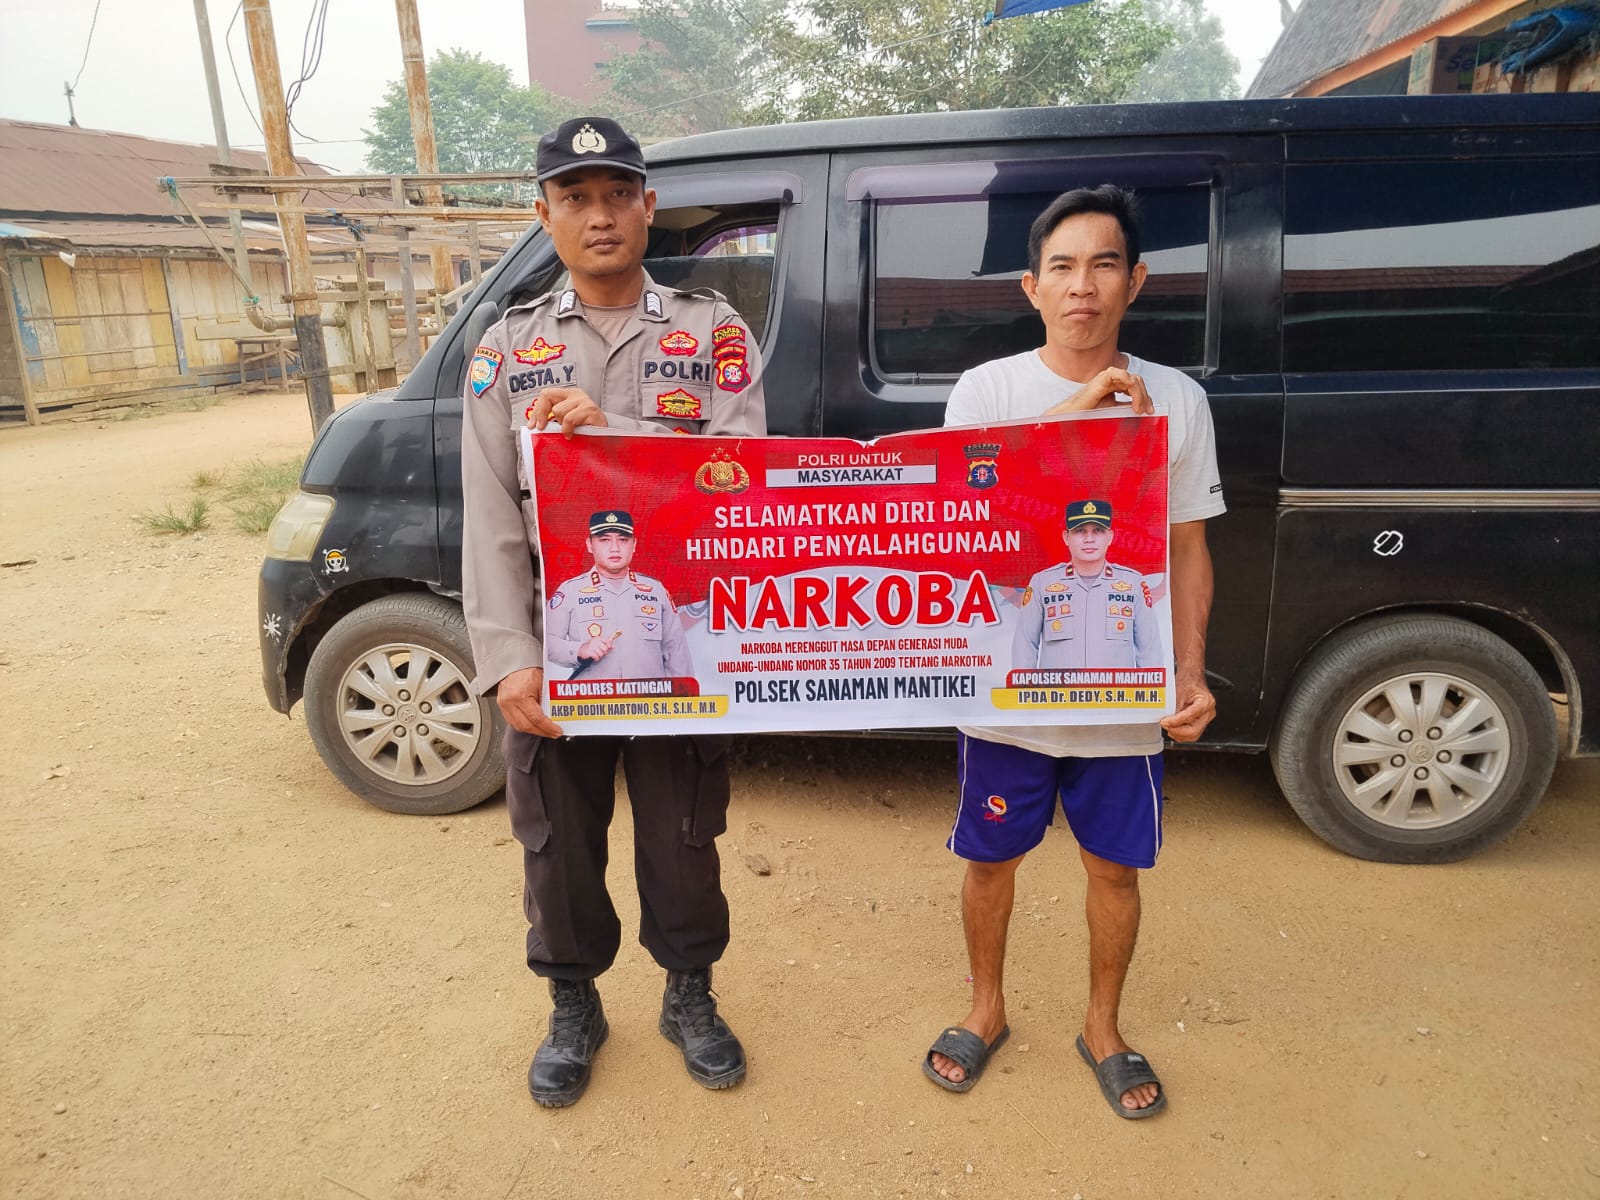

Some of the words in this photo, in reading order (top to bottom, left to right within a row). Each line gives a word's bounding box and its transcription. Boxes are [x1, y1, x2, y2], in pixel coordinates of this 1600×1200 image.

[563, 365, 574, 382] Y
[644, 361, 710, 381] POLRI
[798, 453, 844, 466] POLRI
[849, 451, 902, 465] UNTUK
[798, 467, 904, 484] MASYARAKAT
[714, 502, 877, 529] SELAMATKAN
[885, 501, 936, 524] DIRI
[943, 499, 991, 522] DAN
[686, 536, 787, 560] HINDARI
[793, 530, 1021, 558] PENYALAHGUNAAN
[710, 571, 999, 632] NARKOBA
[1043, 593, 1073, 605] DEDY
[1107, 594, 1135, 603] POLRI
[741, 642, 783, 654] NARKOBA
[785, 640, 838, 654] MERENGGUT
[840, 640, 865, 652] MASA
[867, 640, 896, 651] DEPAN
[898, 638, 941, 651] GENERASI
[943, 637, 968, 649] MUDA
[717, 659, 794, 673] UNDANG-UNDANG
[796, 659, 827, 671] NOMOR
[829, 658, 840, 670] 35
[842, 658, 872, 670] TAHUN
[874, 657, 896, 669] 2009
[898, 656, 939, 668] TENTANG
[941, 654, 992, 667] NARKOTIKA
[1012, 672, 1062, 685] KAPOLSEK
[1063, 672, 1112, 684] SANAMAN
[1115, 672, 1163, 684] MANTIKEI
[556, 683, 613, 696] KAPOLRES
[615, 680, 672, 694] KATINGAN
[735, 679, 800, 703] POLSEK
[805, 676, 888, 701] SANAMAN
[894, 675, 976, 698] MANTIKEI
[1018, 692, 1047, 703] IPDA
[1050, 692, 1066, 703] Dr.
[1069, 691, 1102, 703] DEDY,
[1134, 691, 1161, 702] M.H.
[551, 705, 575, 717] AKBP
[577, 704, 605, 716] DODIK
[607, 702, 651, 716] HARTONO,
[699, 701, 718, 713] M.H.
